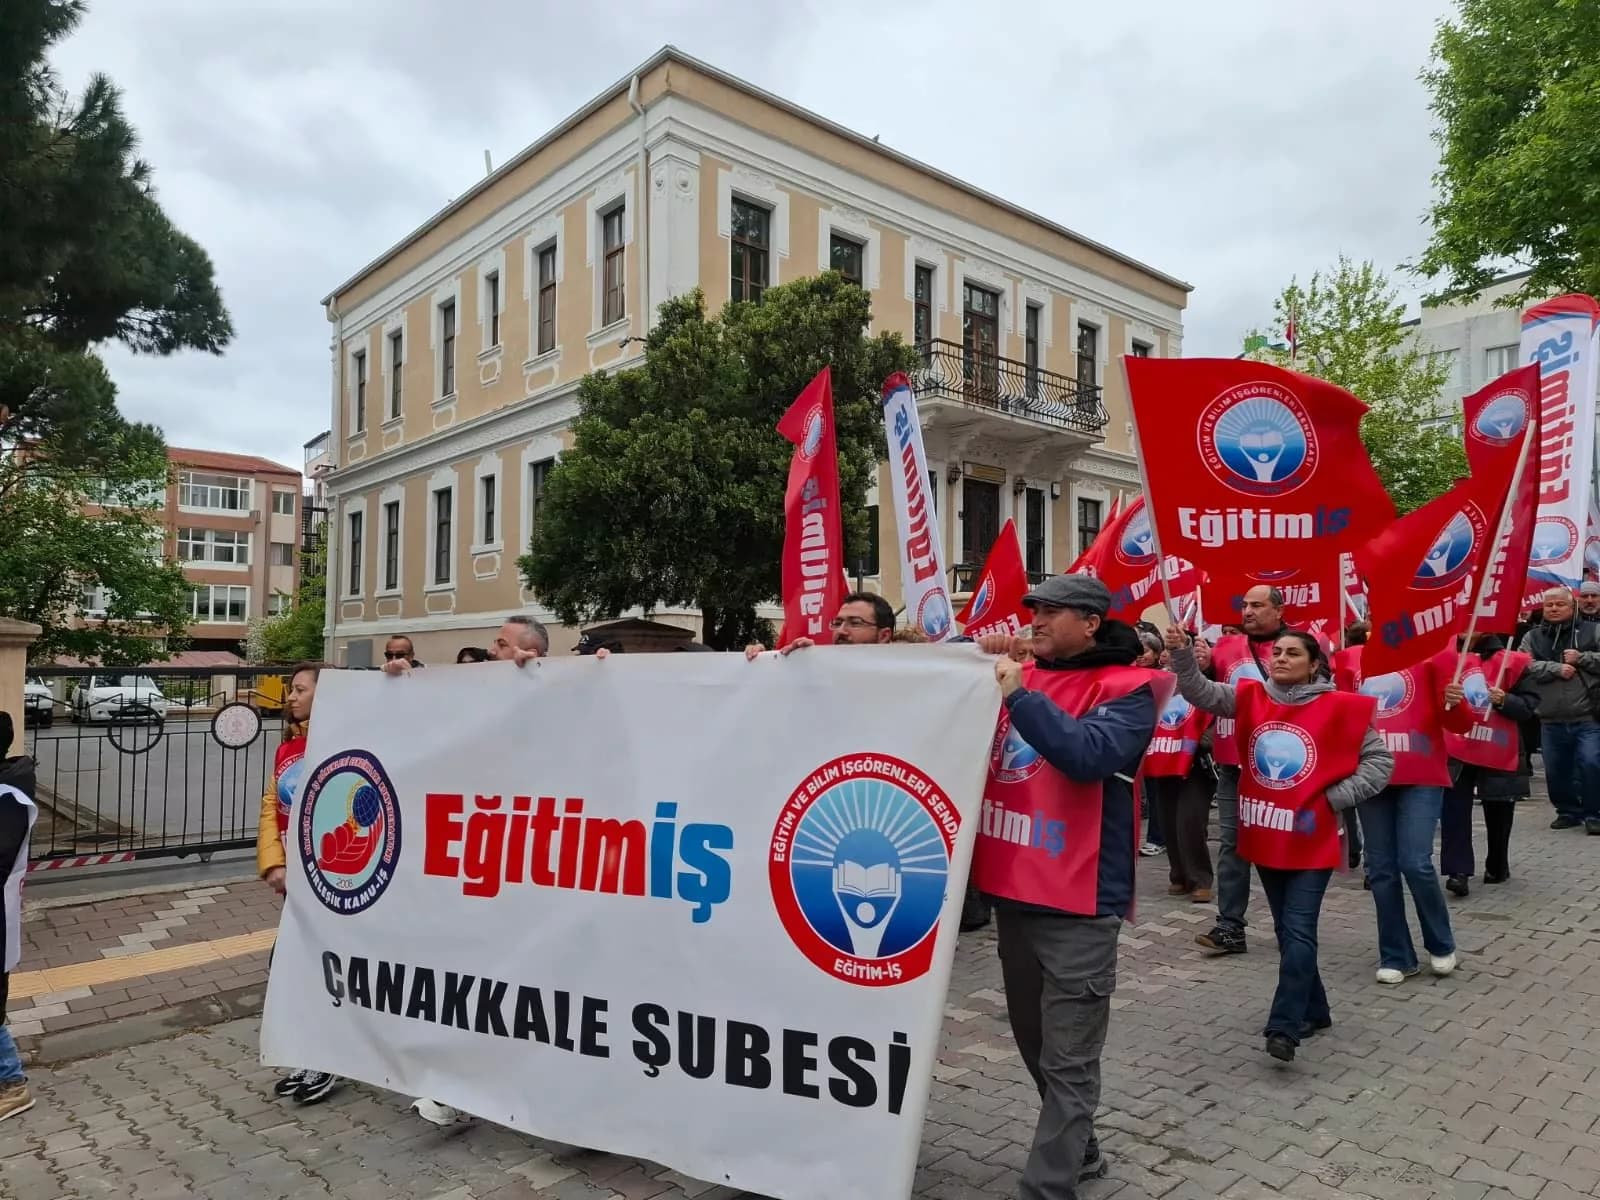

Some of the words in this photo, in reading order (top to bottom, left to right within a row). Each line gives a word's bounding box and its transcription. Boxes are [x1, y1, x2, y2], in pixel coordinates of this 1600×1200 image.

[773, 811, 796, 862] EĞİTİM
[790, 791, 809, 811] VE
[806, 765, 840, 795] BİLİM
[840, 757, 932, 797] İŞGÖRENLERİ
[975, 798, 1067, 858] timiş
[307, 861, 341, 909] BİRLEŞİK
[344, 868, 389, 910] KAMU-İŞ
[833, 958, 903, 980] EĞİTİM-İŞ
[321, 950, 611, 1059] ÇANAKKALE
[631, 1002, 912, 1115] ŞUBESİ
